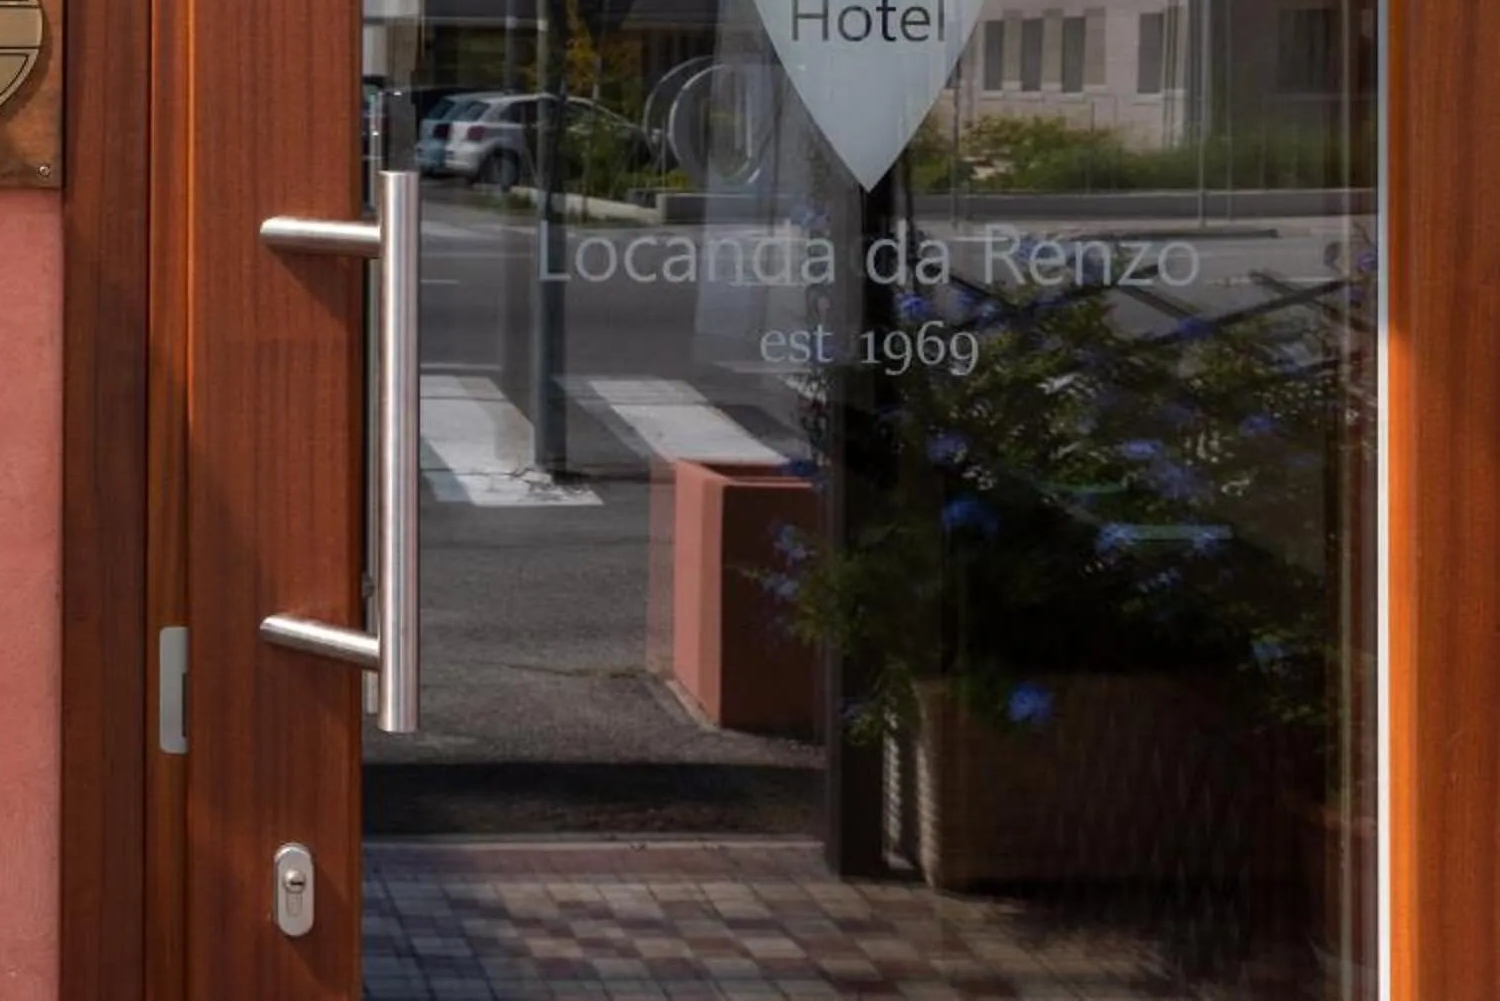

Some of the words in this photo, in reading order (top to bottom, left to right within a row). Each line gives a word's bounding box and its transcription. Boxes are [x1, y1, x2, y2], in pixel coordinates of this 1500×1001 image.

[537, 218, 836, 287] Locanda
[866, 218, 951, 287] da
[984, 222, 1200, 287] Renzo
[760, 324, 833, 365] est
[860, 320, 980, 377] 1969
